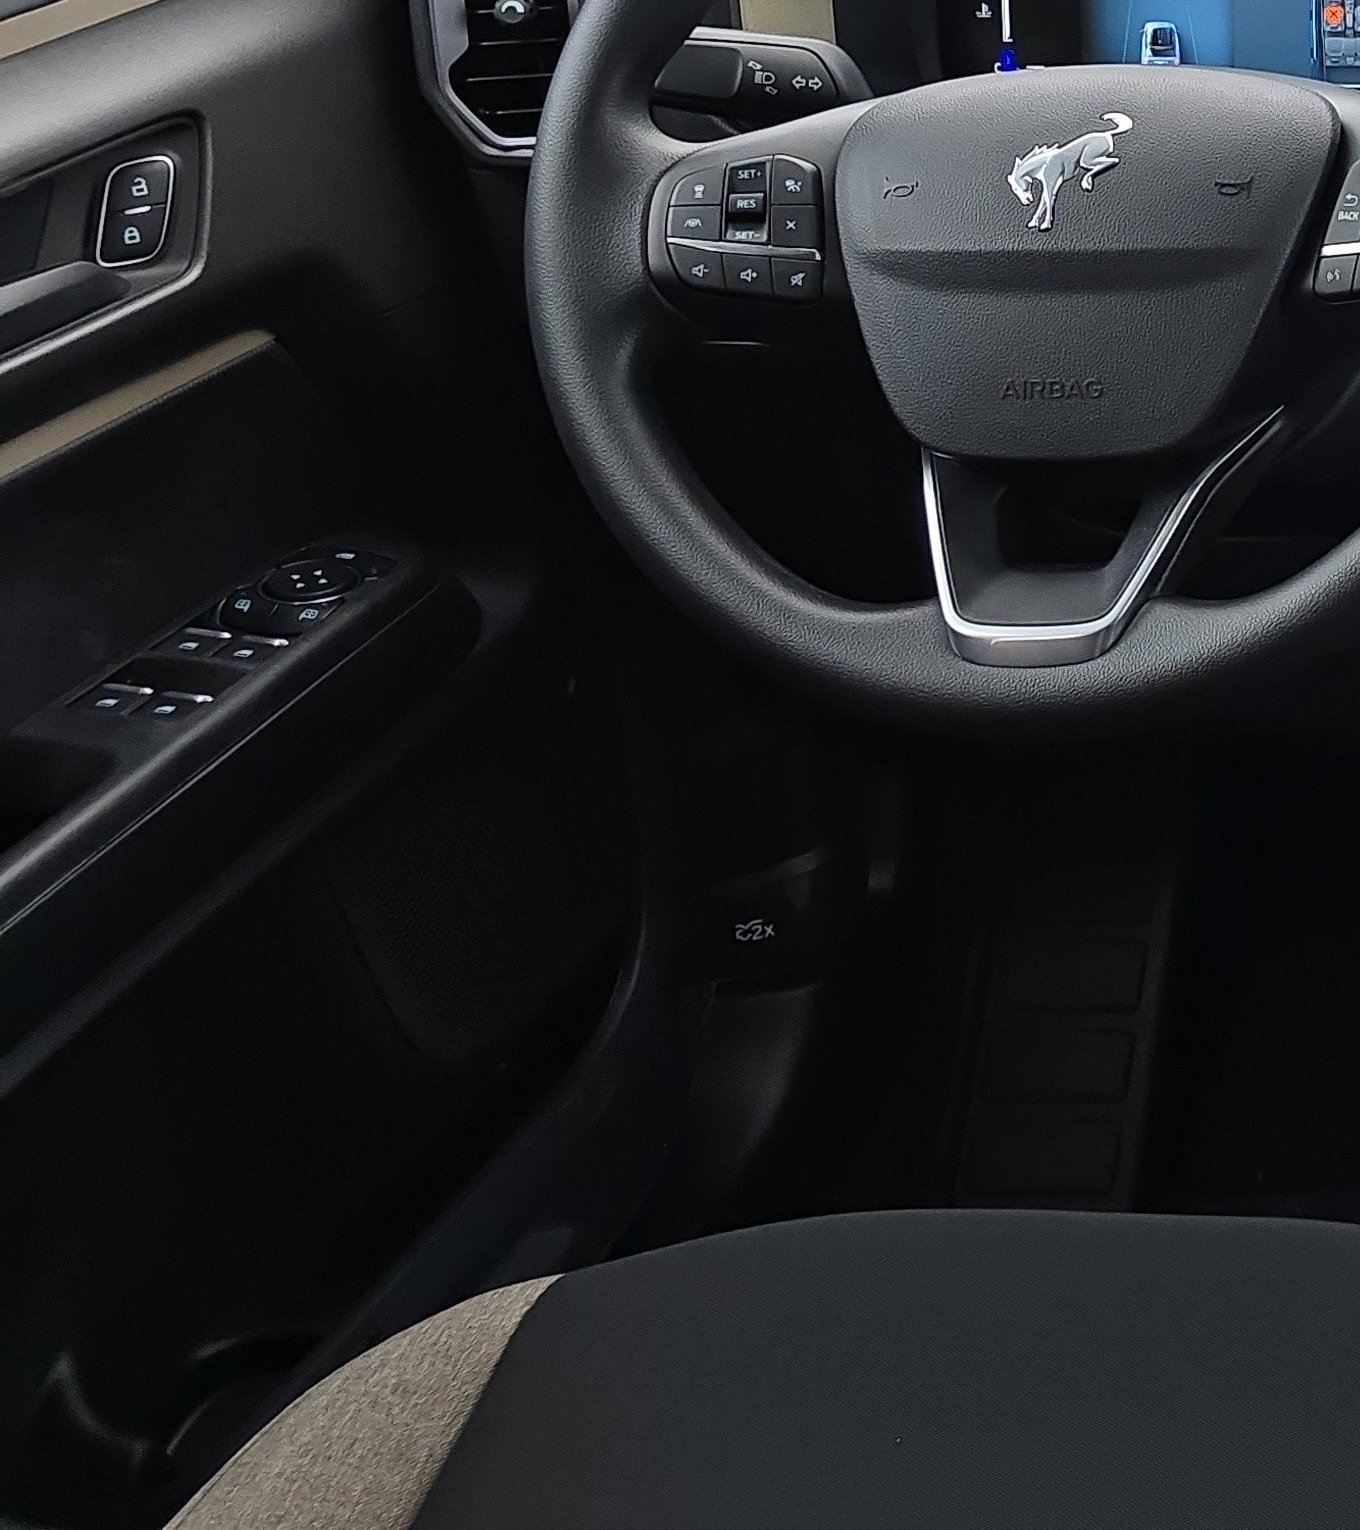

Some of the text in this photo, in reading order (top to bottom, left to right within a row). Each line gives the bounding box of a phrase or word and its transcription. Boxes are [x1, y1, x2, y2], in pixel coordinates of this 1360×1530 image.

[736, 199, 756, 208] RES
[1338, 210, 1360, 221] BACK
[1001, 378, 1104, 400] AIRBAG
